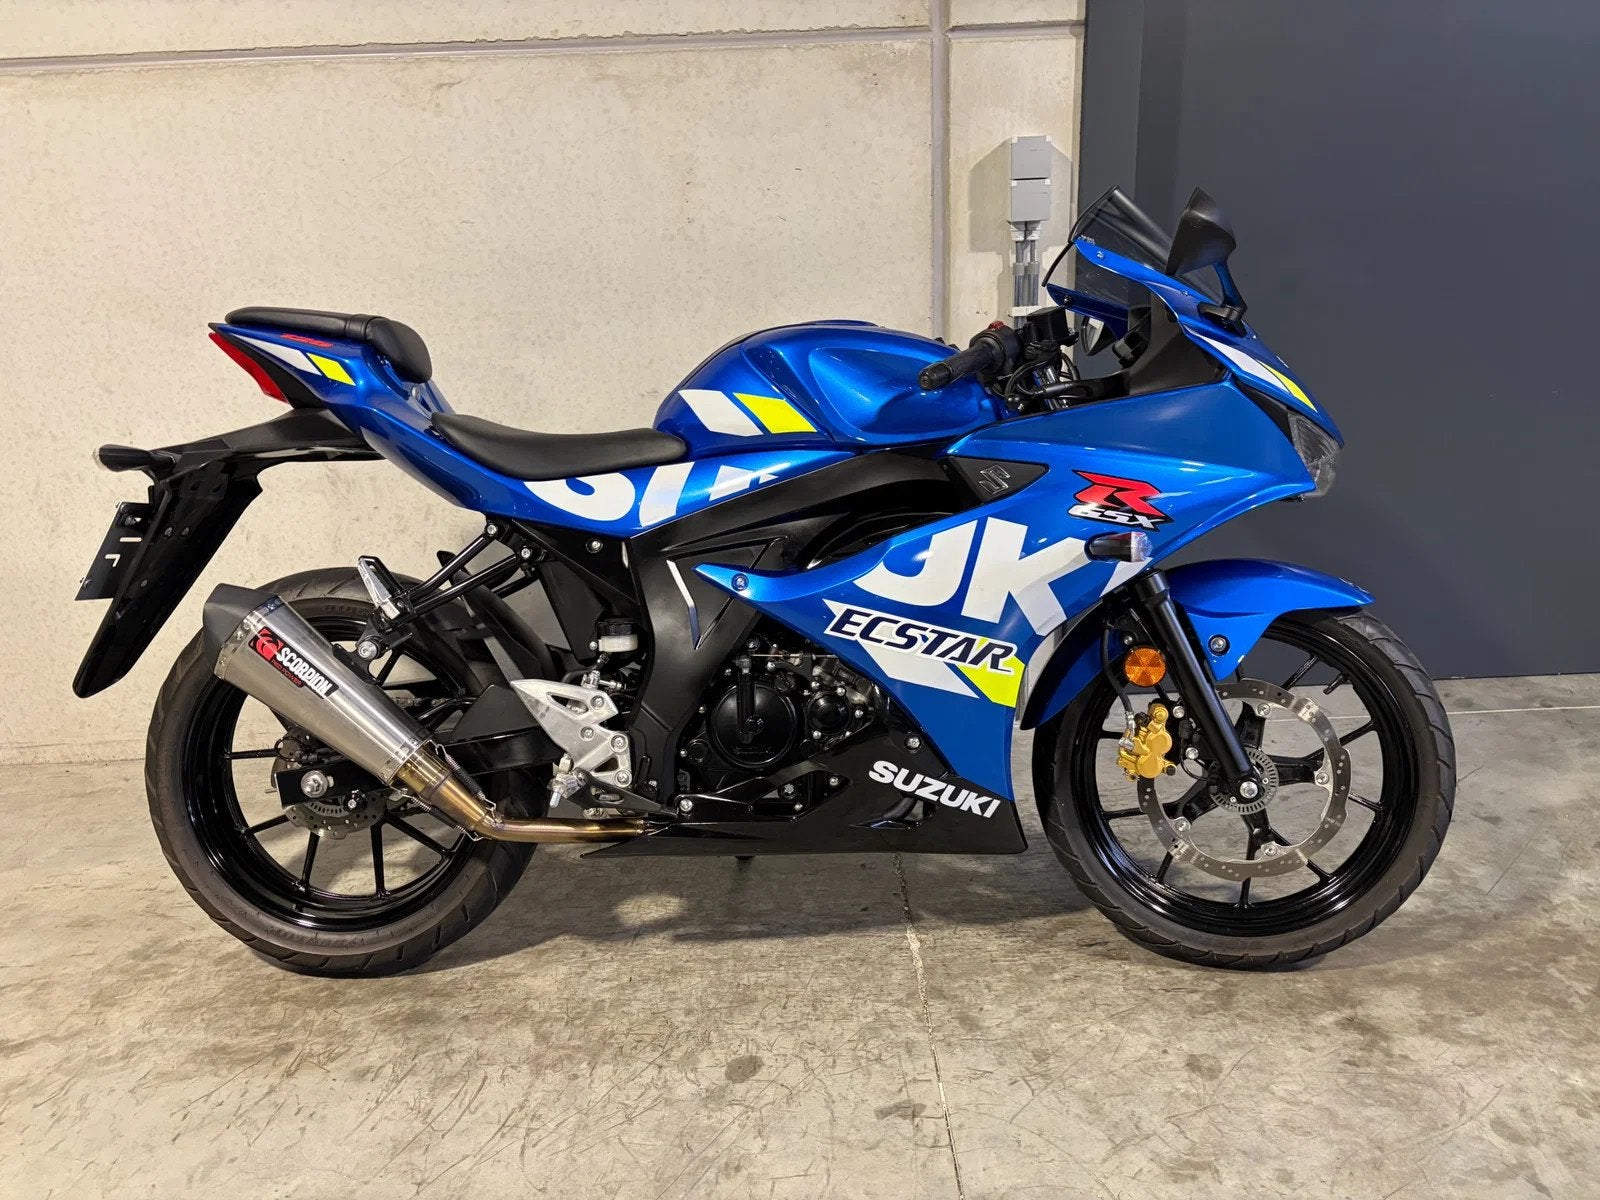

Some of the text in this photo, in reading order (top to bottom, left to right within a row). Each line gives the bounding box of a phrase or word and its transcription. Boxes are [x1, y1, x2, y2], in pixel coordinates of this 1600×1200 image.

[829, 608, 1014, 673] ECSTAR
[276, 647, 333, 697] SCORPION
[868, 760, 1001, 819] SUZUKI
